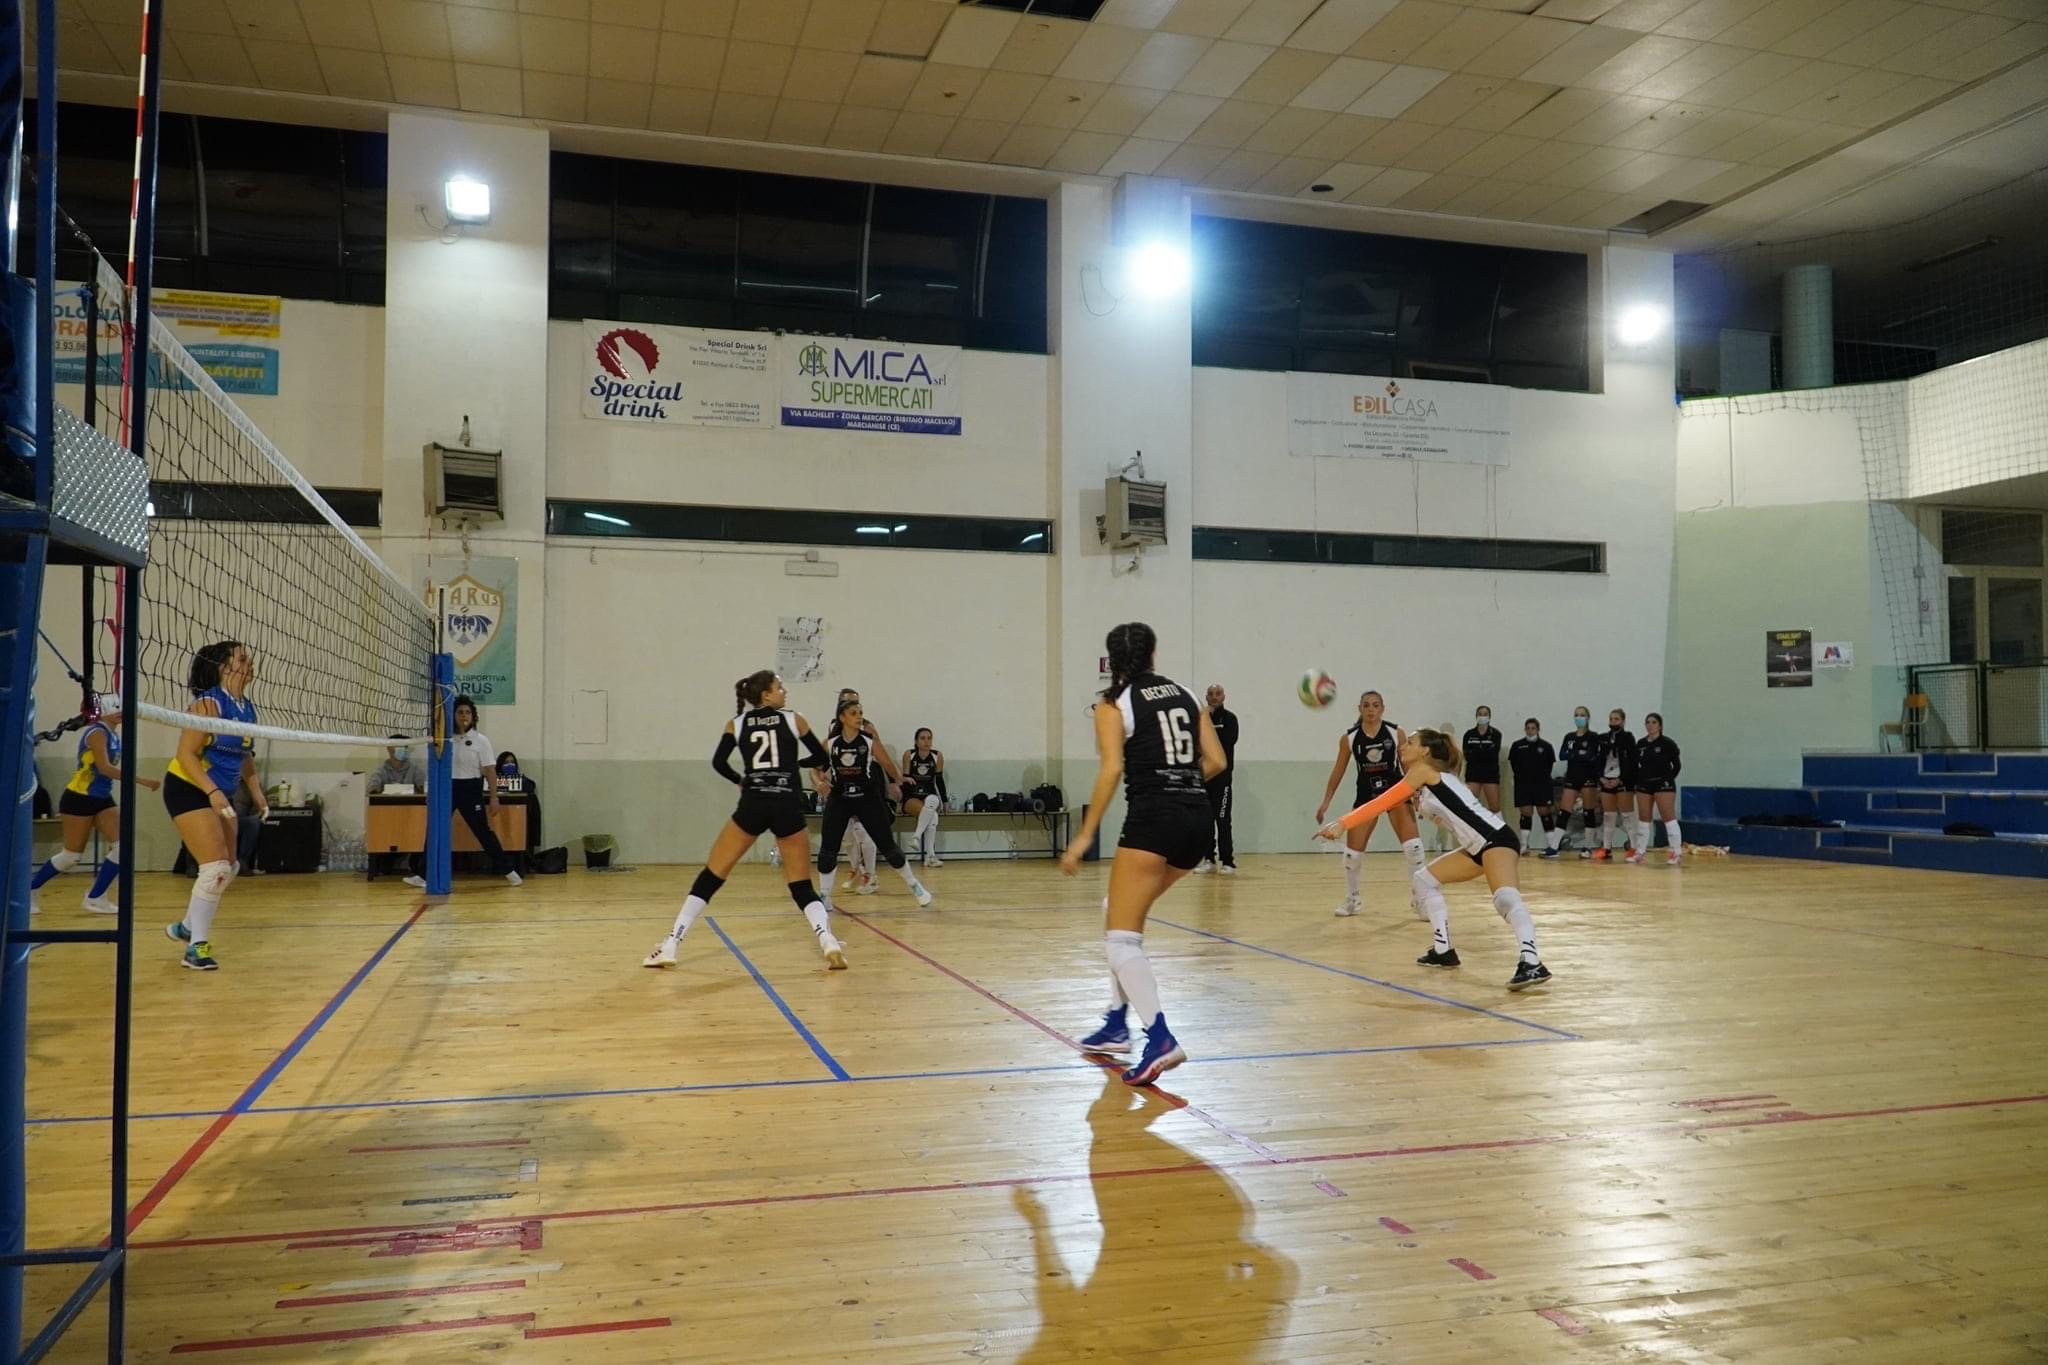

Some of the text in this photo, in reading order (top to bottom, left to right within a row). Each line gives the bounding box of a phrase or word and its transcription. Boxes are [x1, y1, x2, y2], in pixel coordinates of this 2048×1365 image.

[708, 339, 733, 348] Special
[735, 342, 755, 350] Drink
[834, 347, 946, 386] MI.CA srl
[590, 375, 683, 402] Special
[811, 380, 933, 409] SUPERMERCATI
[604, 399, 667, 419] drink
[790, 409, 802, 417] VIA
[803, 410, 834, 419] BACHELET
[841, 412, 860, 420] ZONA
[887, 423, 900, 431] (CE)
[454, 674, 506, 682] OLISPORTIVA
[1156, 707, 1194, 765] 16
[750, 729, 779, 770] 21
